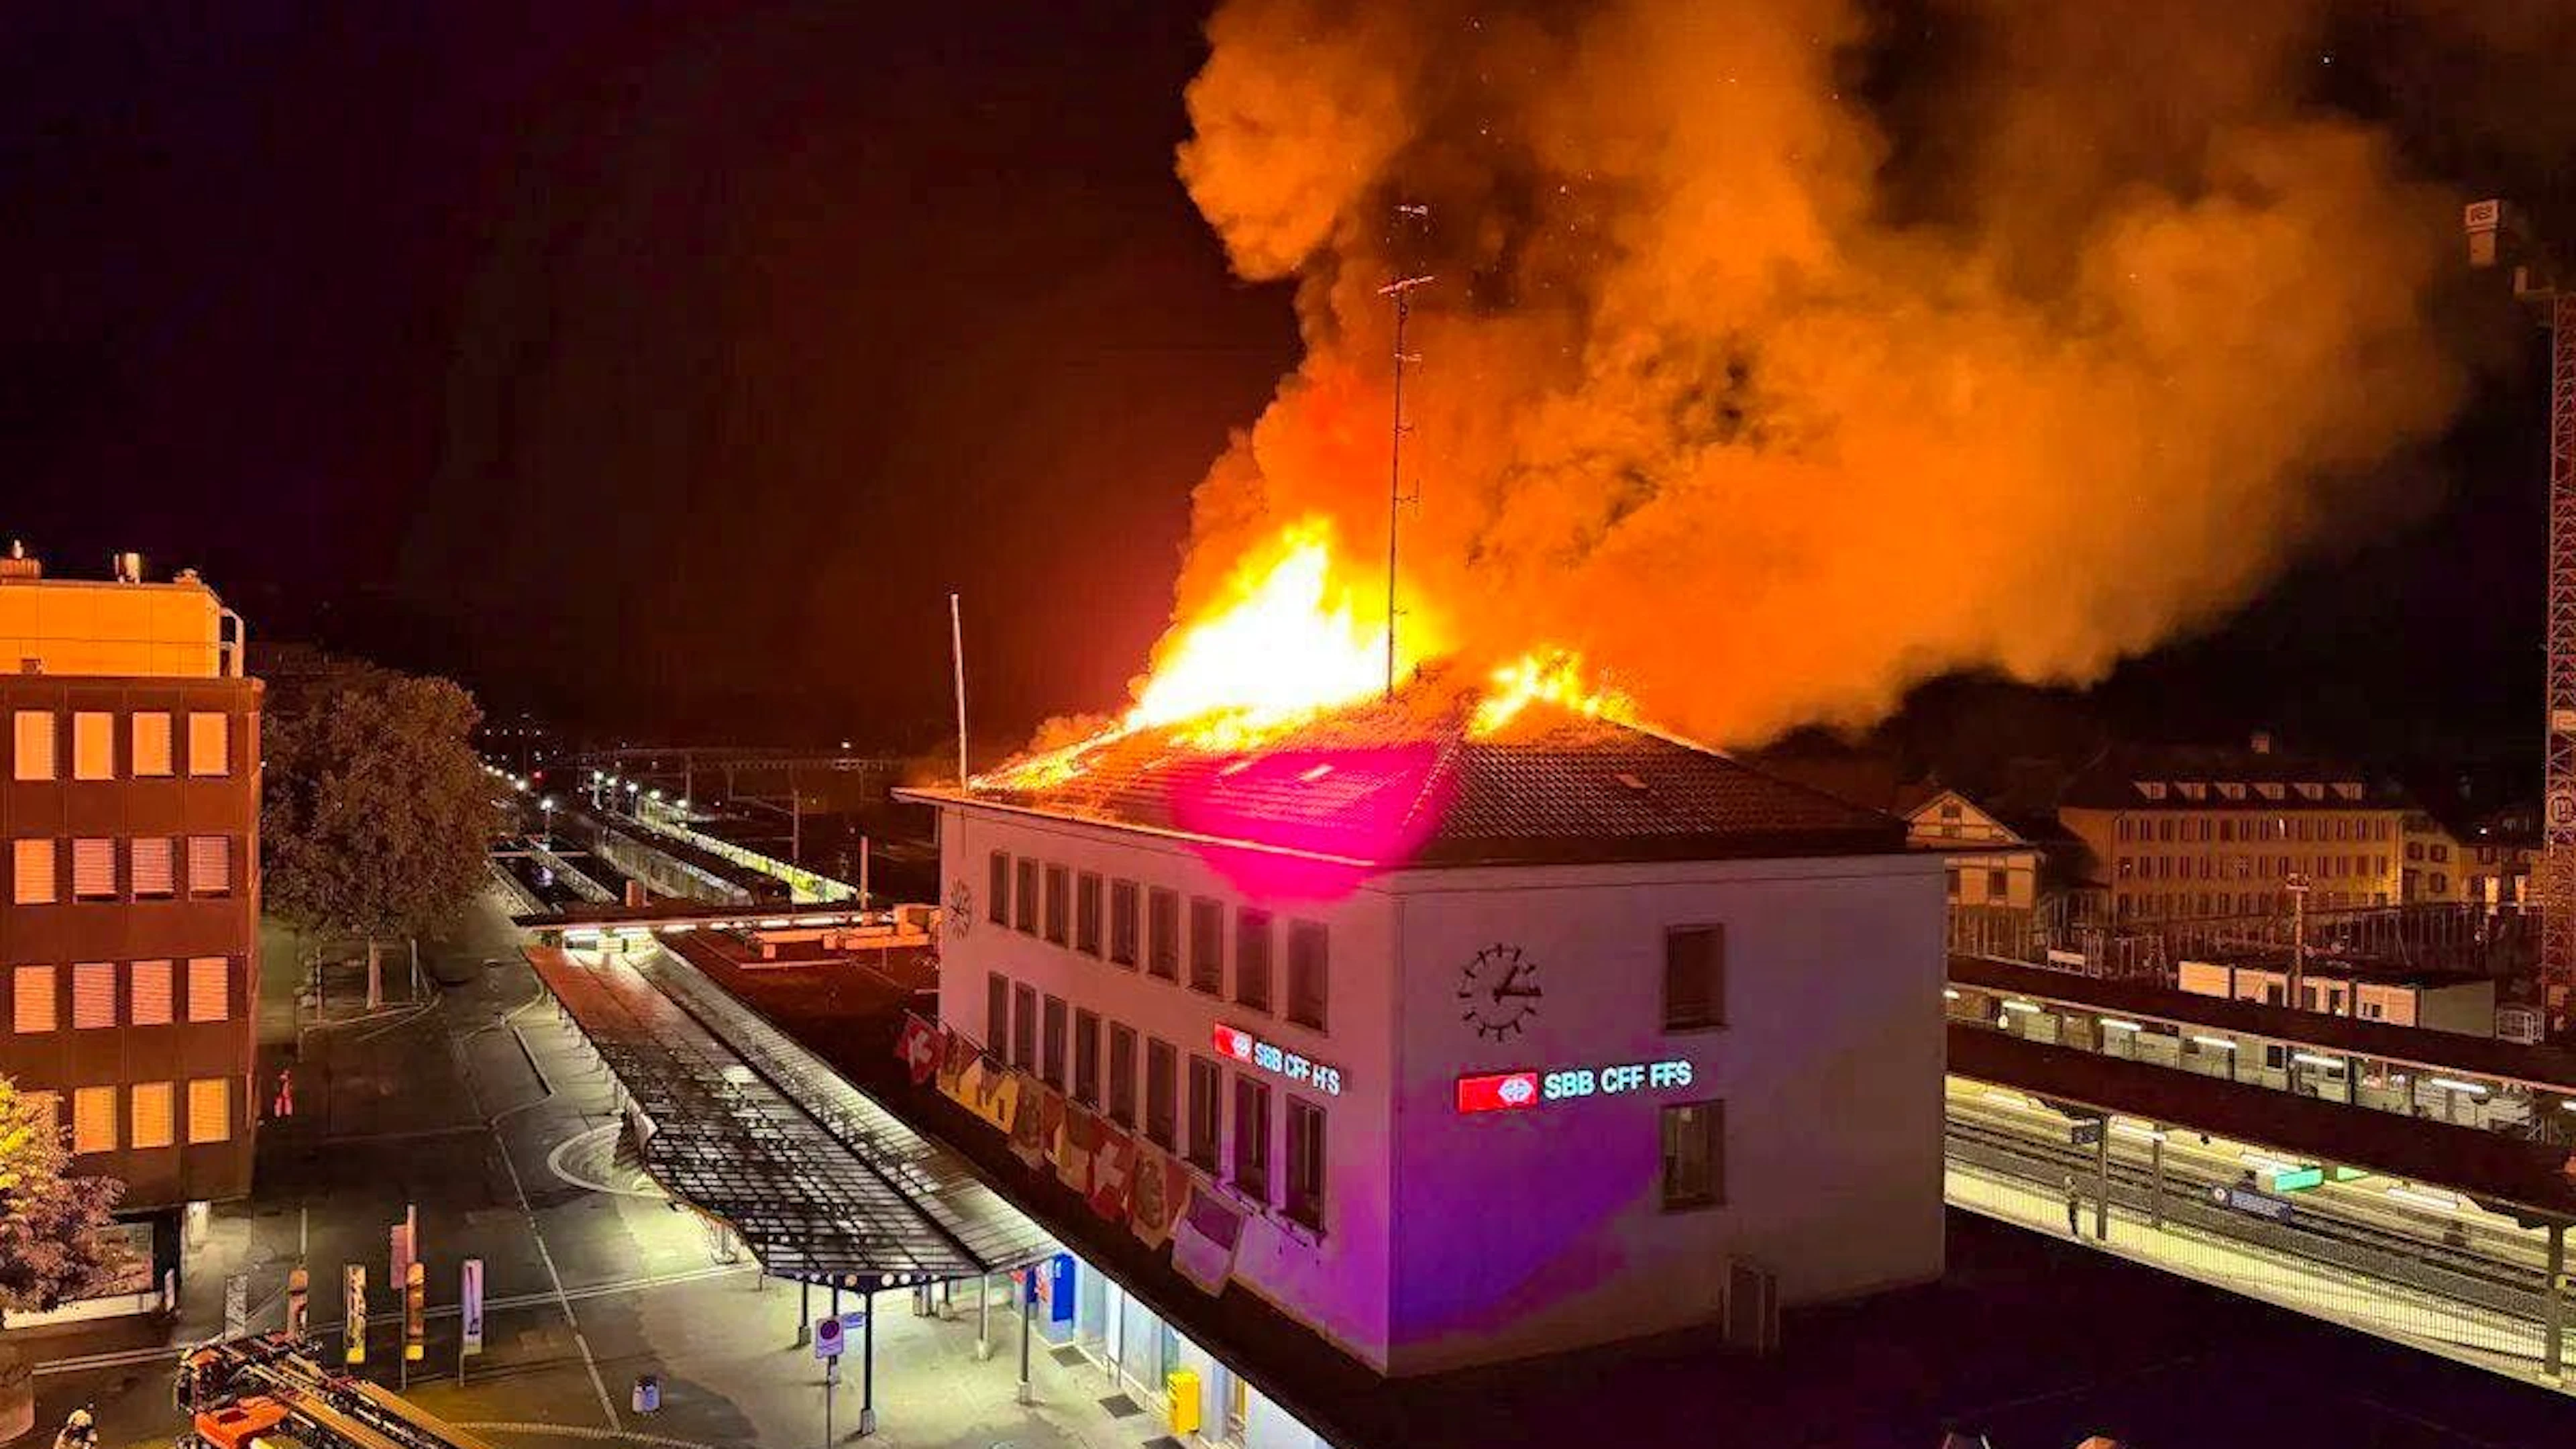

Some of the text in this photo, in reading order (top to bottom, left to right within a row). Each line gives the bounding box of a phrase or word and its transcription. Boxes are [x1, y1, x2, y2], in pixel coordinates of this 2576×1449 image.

[1254, 1041, 1283, 1073] SBB
[1284, 1052, 1311, 1081] CFF
[1544, 1060, 1693, 1099] SBB CFF FFS
